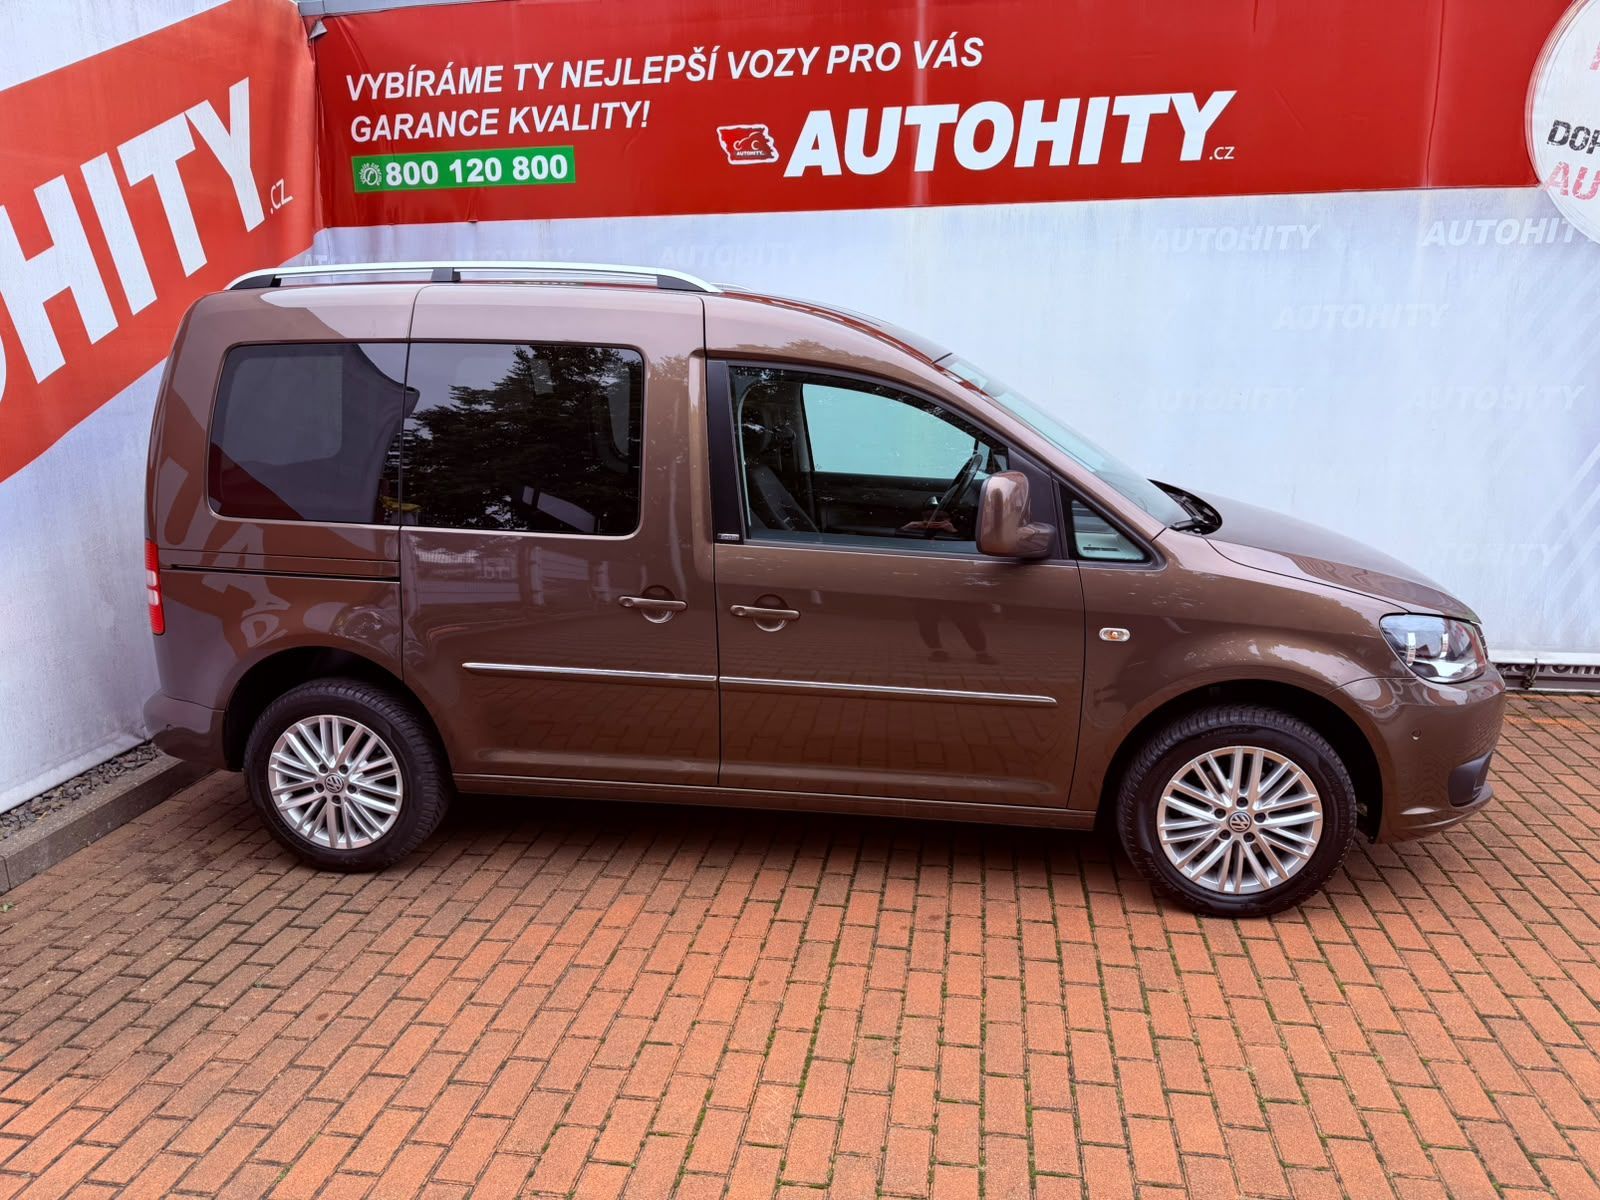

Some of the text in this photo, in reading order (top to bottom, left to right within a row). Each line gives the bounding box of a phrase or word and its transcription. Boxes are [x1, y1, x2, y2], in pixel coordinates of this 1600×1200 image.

[346, 31, 985, 101] VYBÍRÁME TY NEJLEPŠÍ VOZY PRO VÁS
[351, 100, 651, 143] GARANCE KVALITY!
[385, 161, 439, 186] 800
[449, 158, 503, 183] 120
[512, 154, 568, 180] 800
[0, 76, 265, 404] HITY
[1420, 217, 1592, 248] AUTOHIT
